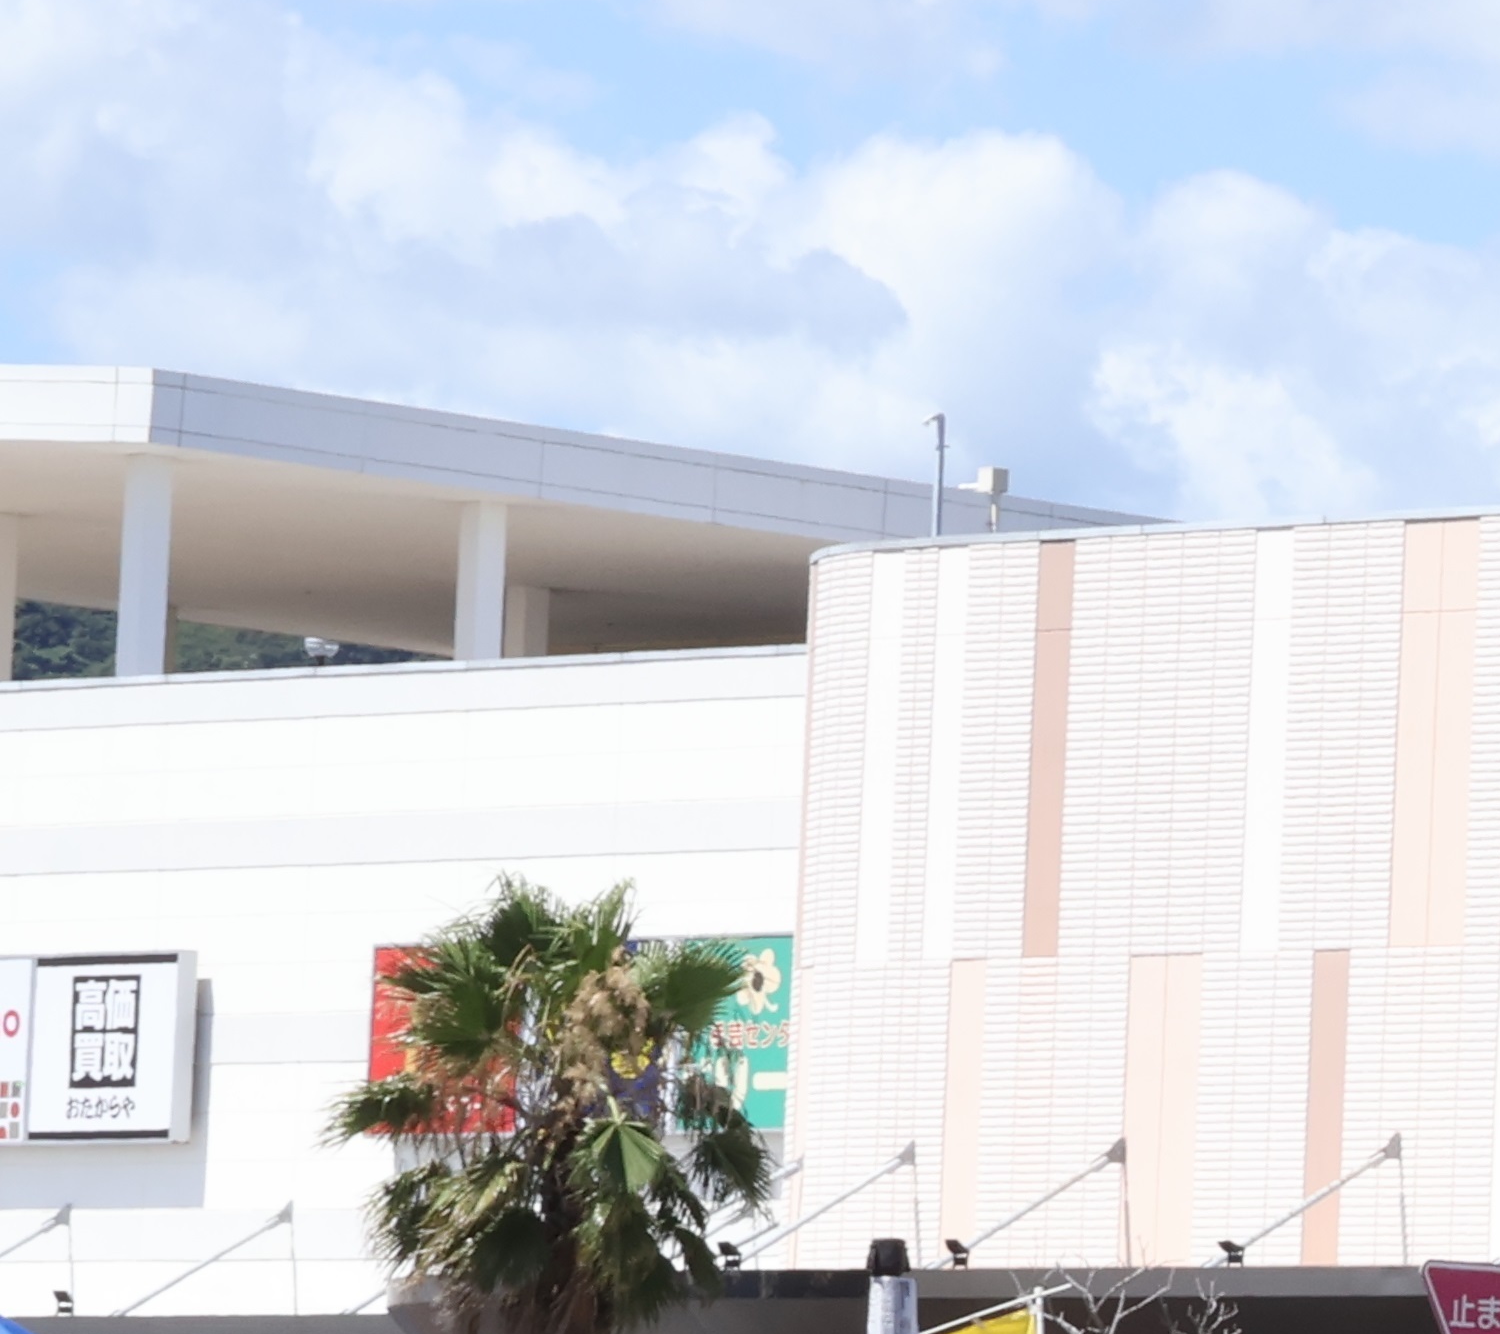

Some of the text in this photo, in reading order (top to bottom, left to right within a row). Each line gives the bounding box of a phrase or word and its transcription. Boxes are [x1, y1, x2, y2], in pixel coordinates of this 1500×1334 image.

[74, 979, 139, 1031] 高価
[72, 1032, 136, 1082] 買取
[66, 1095, 136, 1120] おたからや
